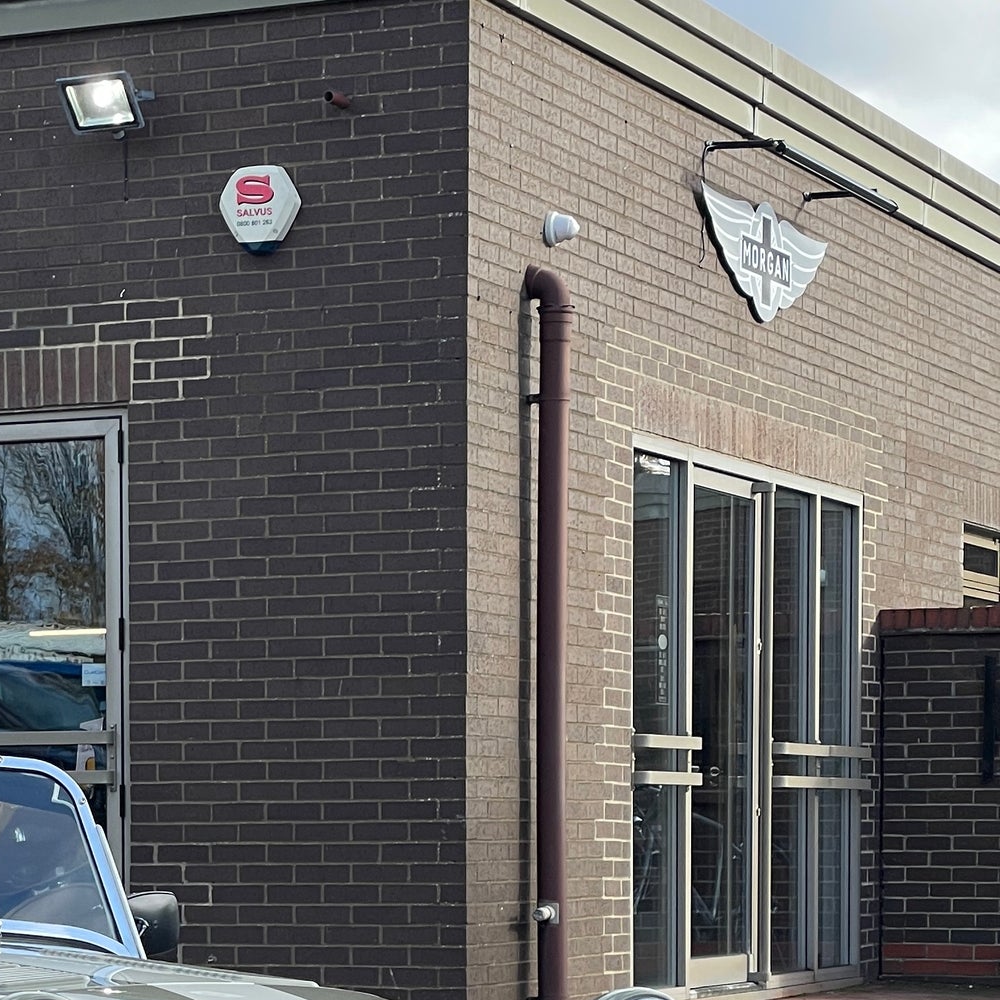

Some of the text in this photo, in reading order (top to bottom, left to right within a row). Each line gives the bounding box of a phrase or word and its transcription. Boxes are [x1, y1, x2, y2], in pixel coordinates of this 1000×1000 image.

[235, 174, 275, 206] S
[236, 207, 273, 218] SALVUS
[743, 242, 789, 282] MORGAN
